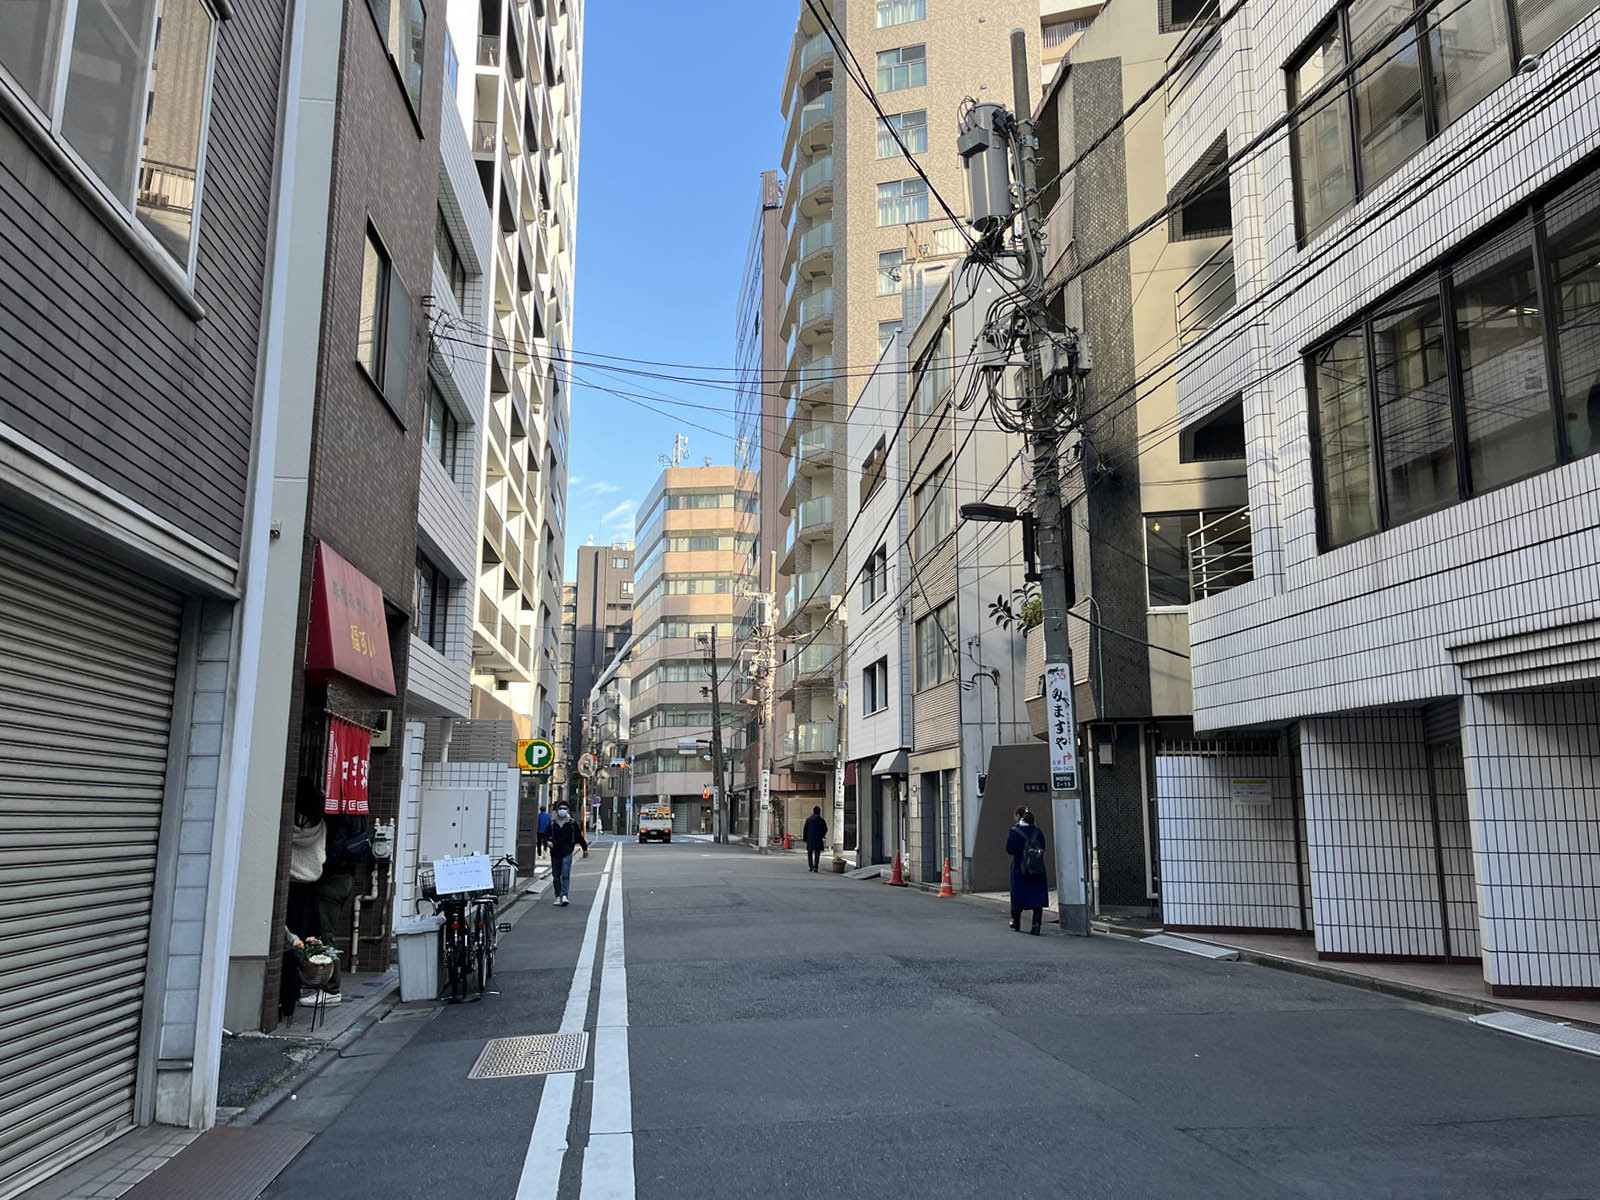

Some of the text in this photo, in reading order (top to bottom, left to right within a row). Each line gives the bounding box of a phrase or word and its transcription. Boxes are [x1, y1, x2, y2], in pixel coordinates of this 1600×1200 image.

[1052, 687, 1070, 750] みますや
[532, 745, 548, 765] P
